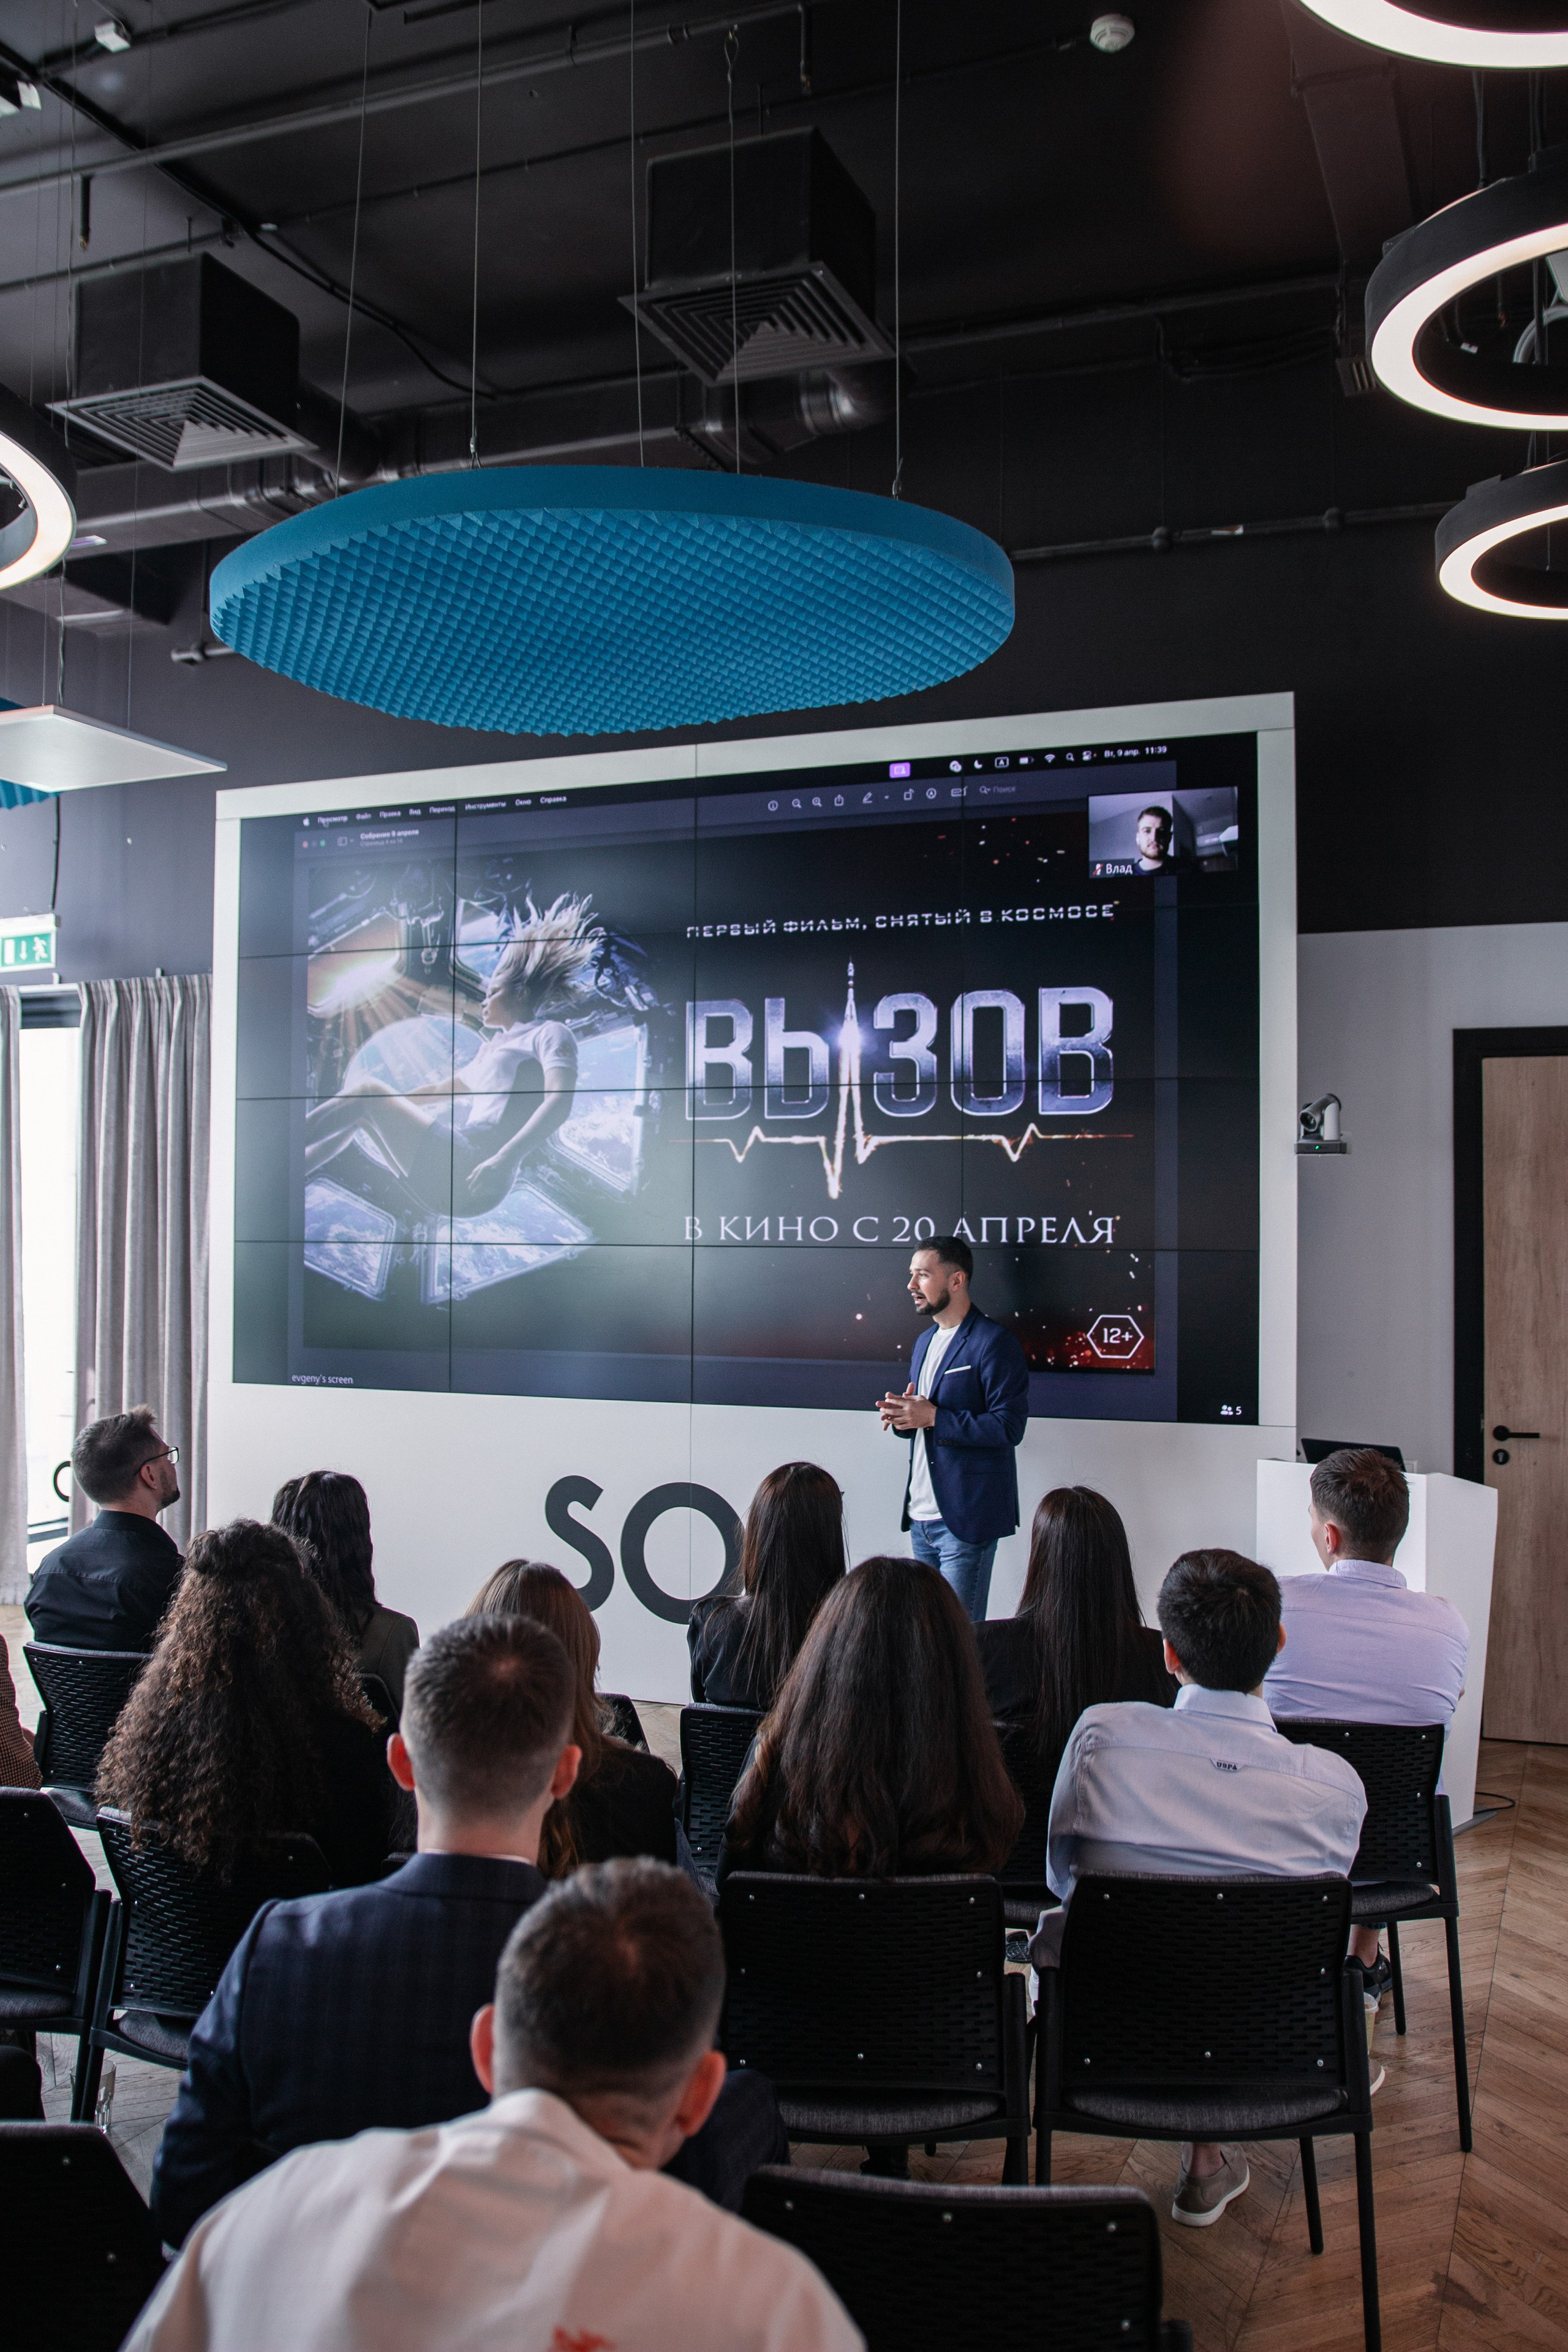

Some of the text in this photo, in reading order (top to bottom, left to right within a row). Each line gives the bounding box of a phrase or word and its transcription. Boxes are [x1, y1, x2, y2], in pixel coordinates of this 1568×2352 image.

[1145, 745, 1167, 755] 11:39
[465, 801, 506, 810] Инструменты
[540, 796, 567, 805] Справка
[1106, 863, 1133, 875] Влад
[687, 904, 1114, 938] ПЕРВЫЙ ФИЛЬМ, СНЯТЫЙ В КОСМОСЕ
[685, 986, 1114, 1120] ВЫЗОВ
[684, 1216, 1114, 1244] В КИНО С 20 АПРЕЛЯ
[1102, 1327, 1133, 1344] 12+
[292, 1374, 354, 1385] evgeny's screen
[1235, 1406, 1242, 1415] 5
[545, 1475, 844, 1624] SO
[1216, 1762, 1237, 1770] USPA
